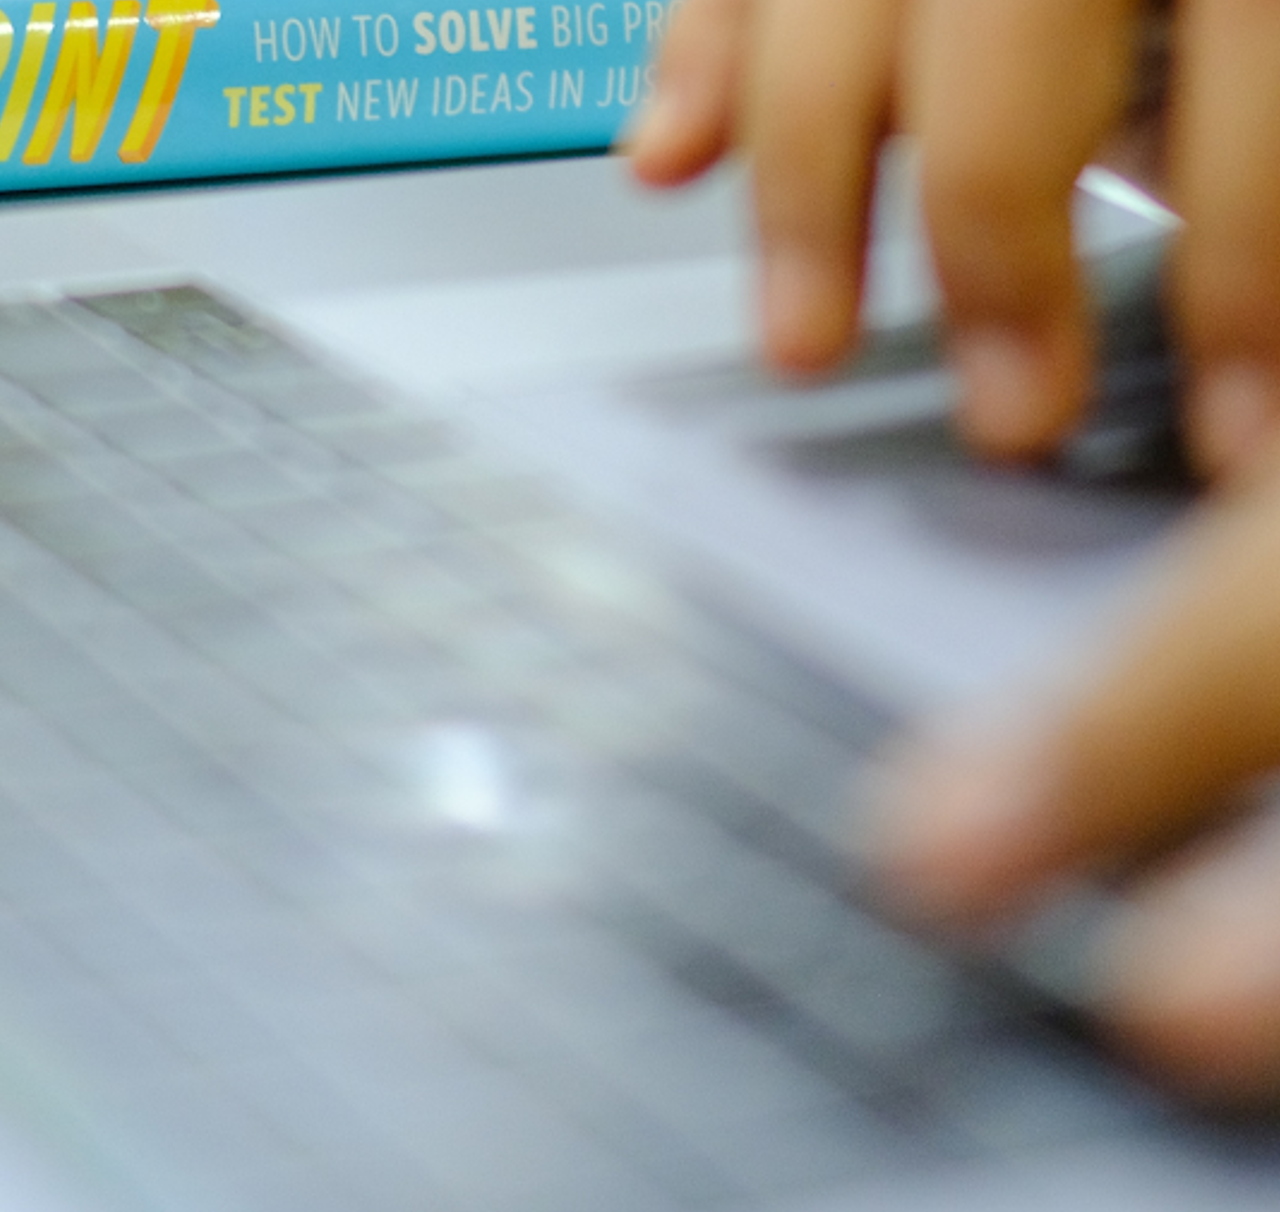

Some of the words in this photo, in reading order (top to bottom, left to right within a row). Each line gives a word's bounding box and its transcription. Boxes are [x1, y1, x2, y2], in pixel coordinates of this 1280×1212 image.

[253, 16, 342, 63] HOW
[352, 13, 400, 58] TO
[412, 6, 539, 55] SOLVE
[551, 2, 610, 48] BIG
[222, 82, 324, 129] TEST
[335, 76, 420, 123] NEW
[431, 70, 536, 117] IDEAS
[547, 68, 585, 110] IN
